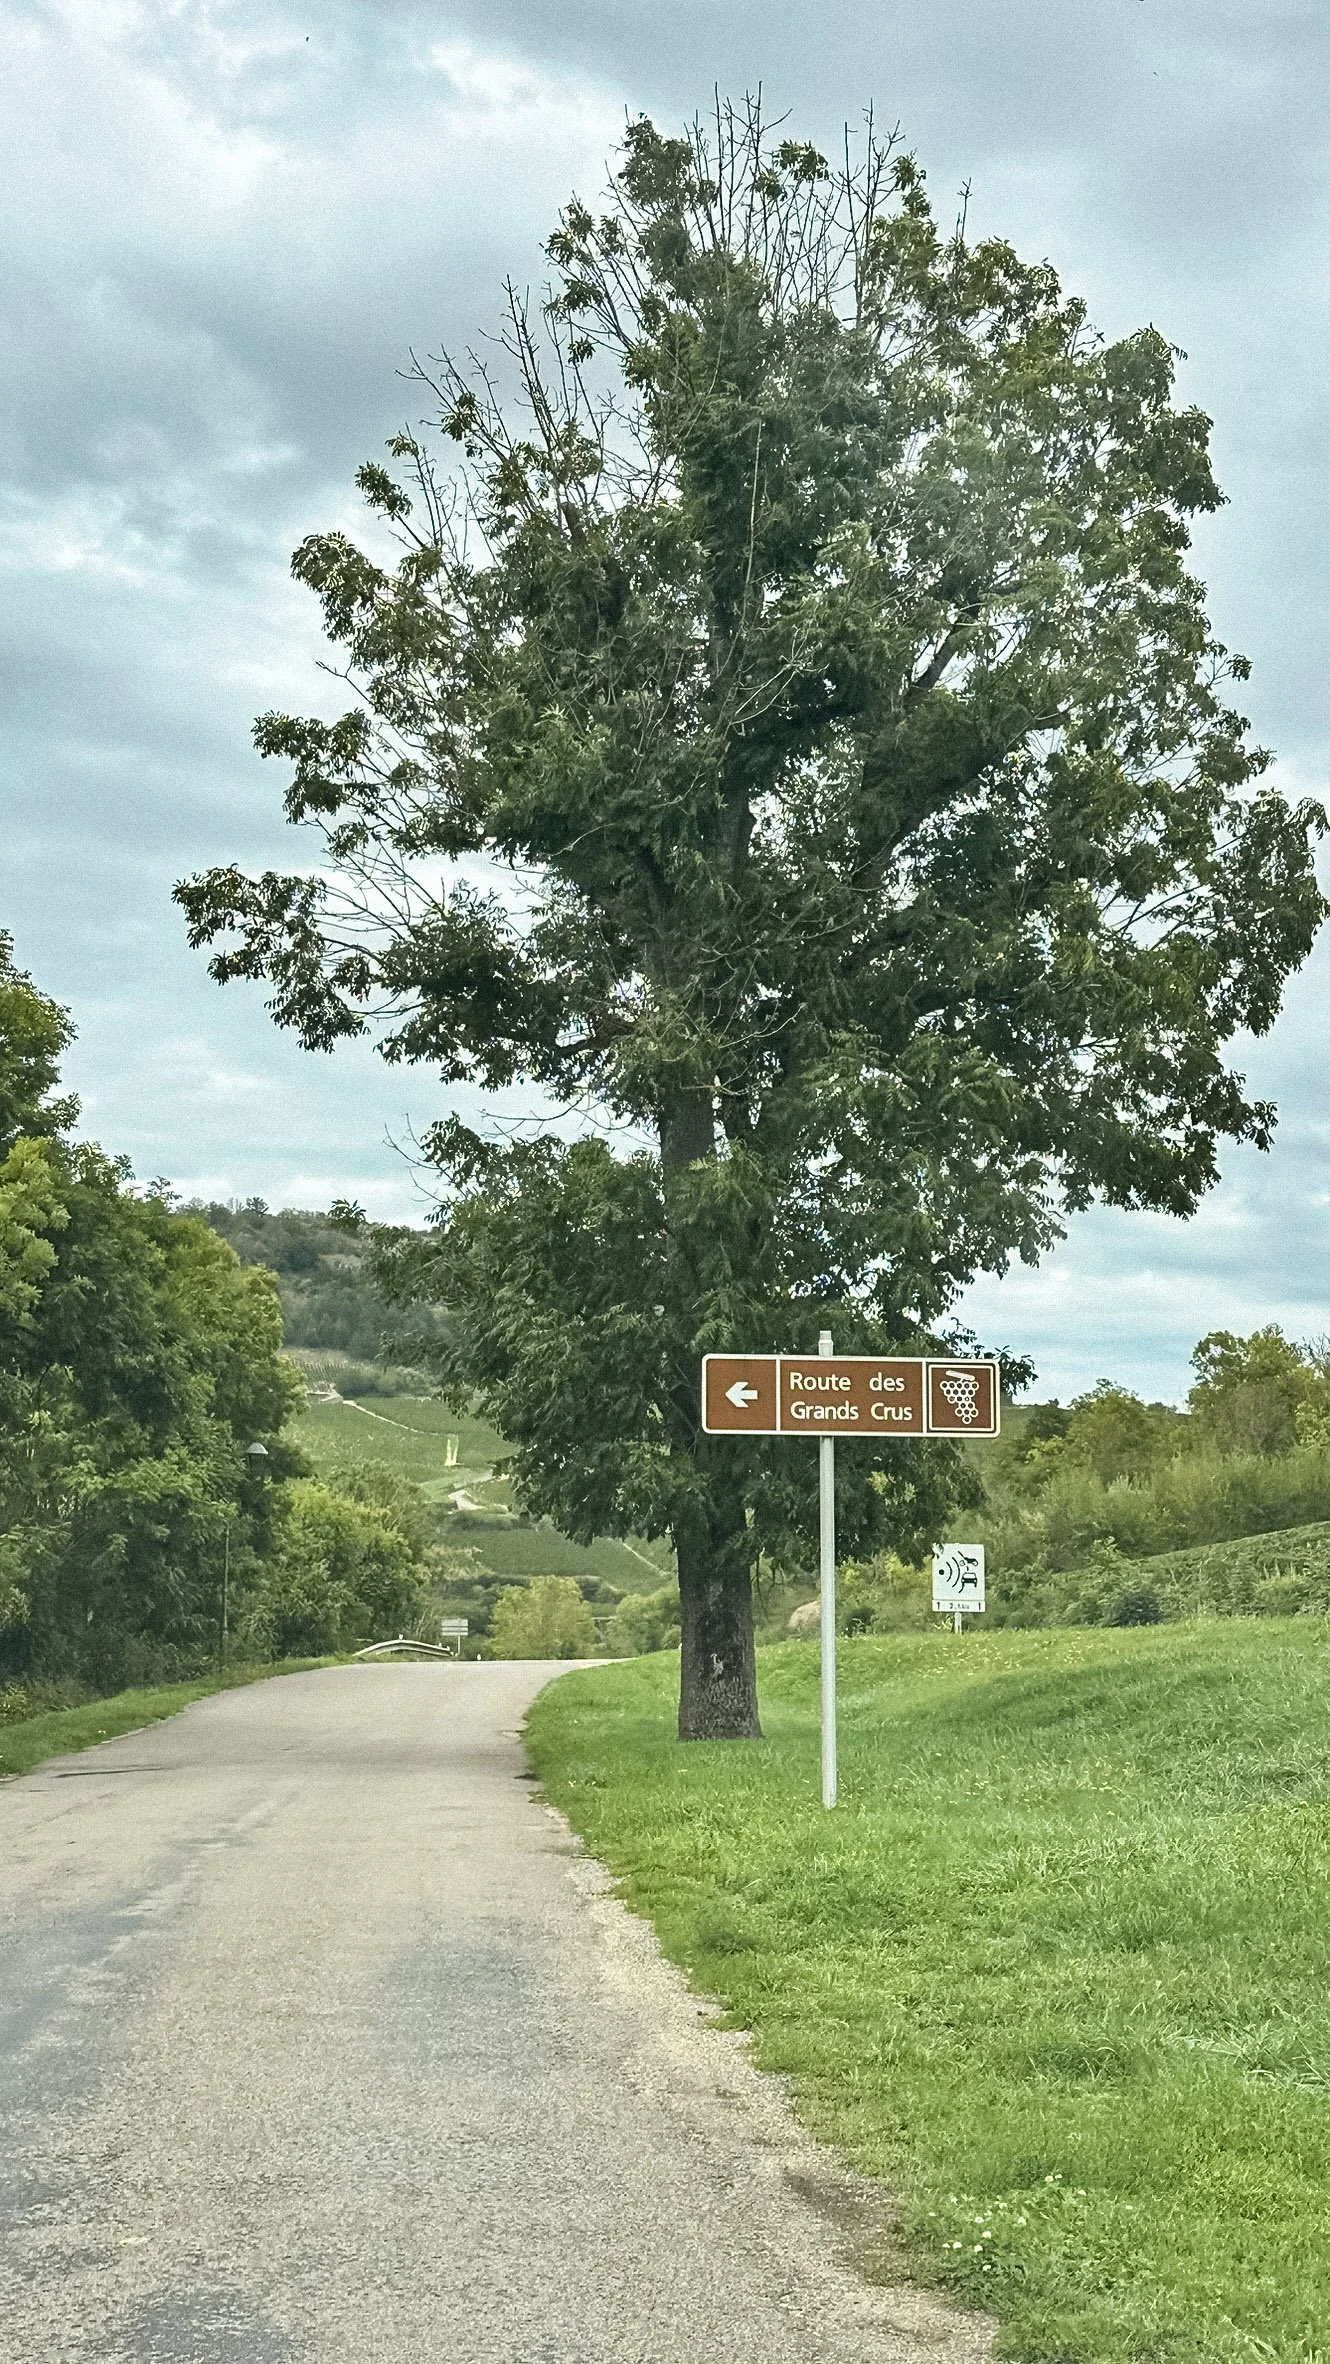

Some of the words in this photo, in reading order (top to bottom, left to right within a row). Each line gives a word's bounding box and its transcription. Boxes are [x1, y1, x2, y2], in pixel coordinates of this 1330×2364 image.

[790, 1372, 851, 1391] Route
[869, 1372, 905, 1392] des
[790, 1401, 859, 1420] Grands
[870, 1402, 912, 1421] Crus
